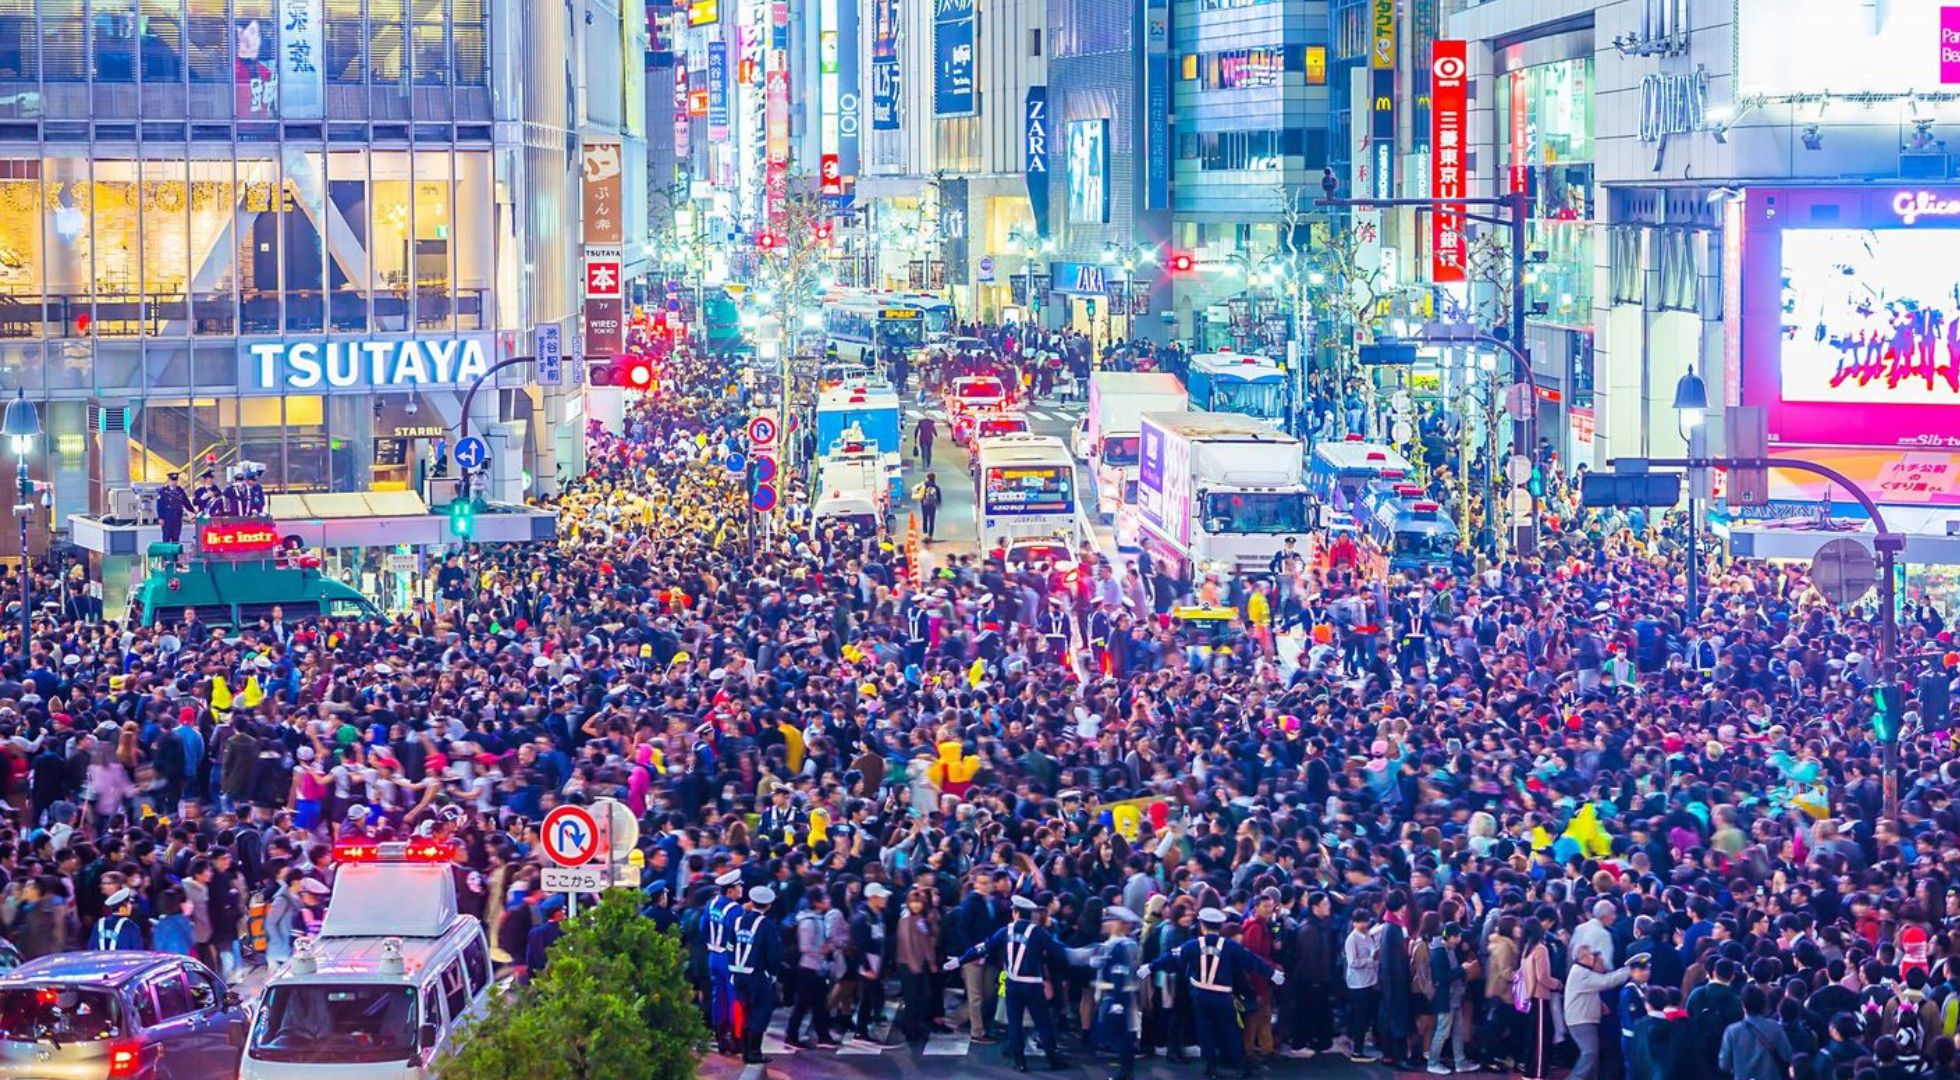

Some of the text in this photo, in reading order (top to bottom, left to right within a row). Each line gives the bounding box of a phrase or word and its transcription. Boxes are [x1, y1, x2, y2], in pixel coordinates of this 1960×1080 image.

[1028, 101, 1047, 172] ZARA
[591, 266, 615, 291] 本
[1075, 266, 1104, 291] ZARA
[590, 320, 617, 328] WIRED
[251, 340, 487, 388] TSUTAYA
[546, 874, 596, 888] ここから
